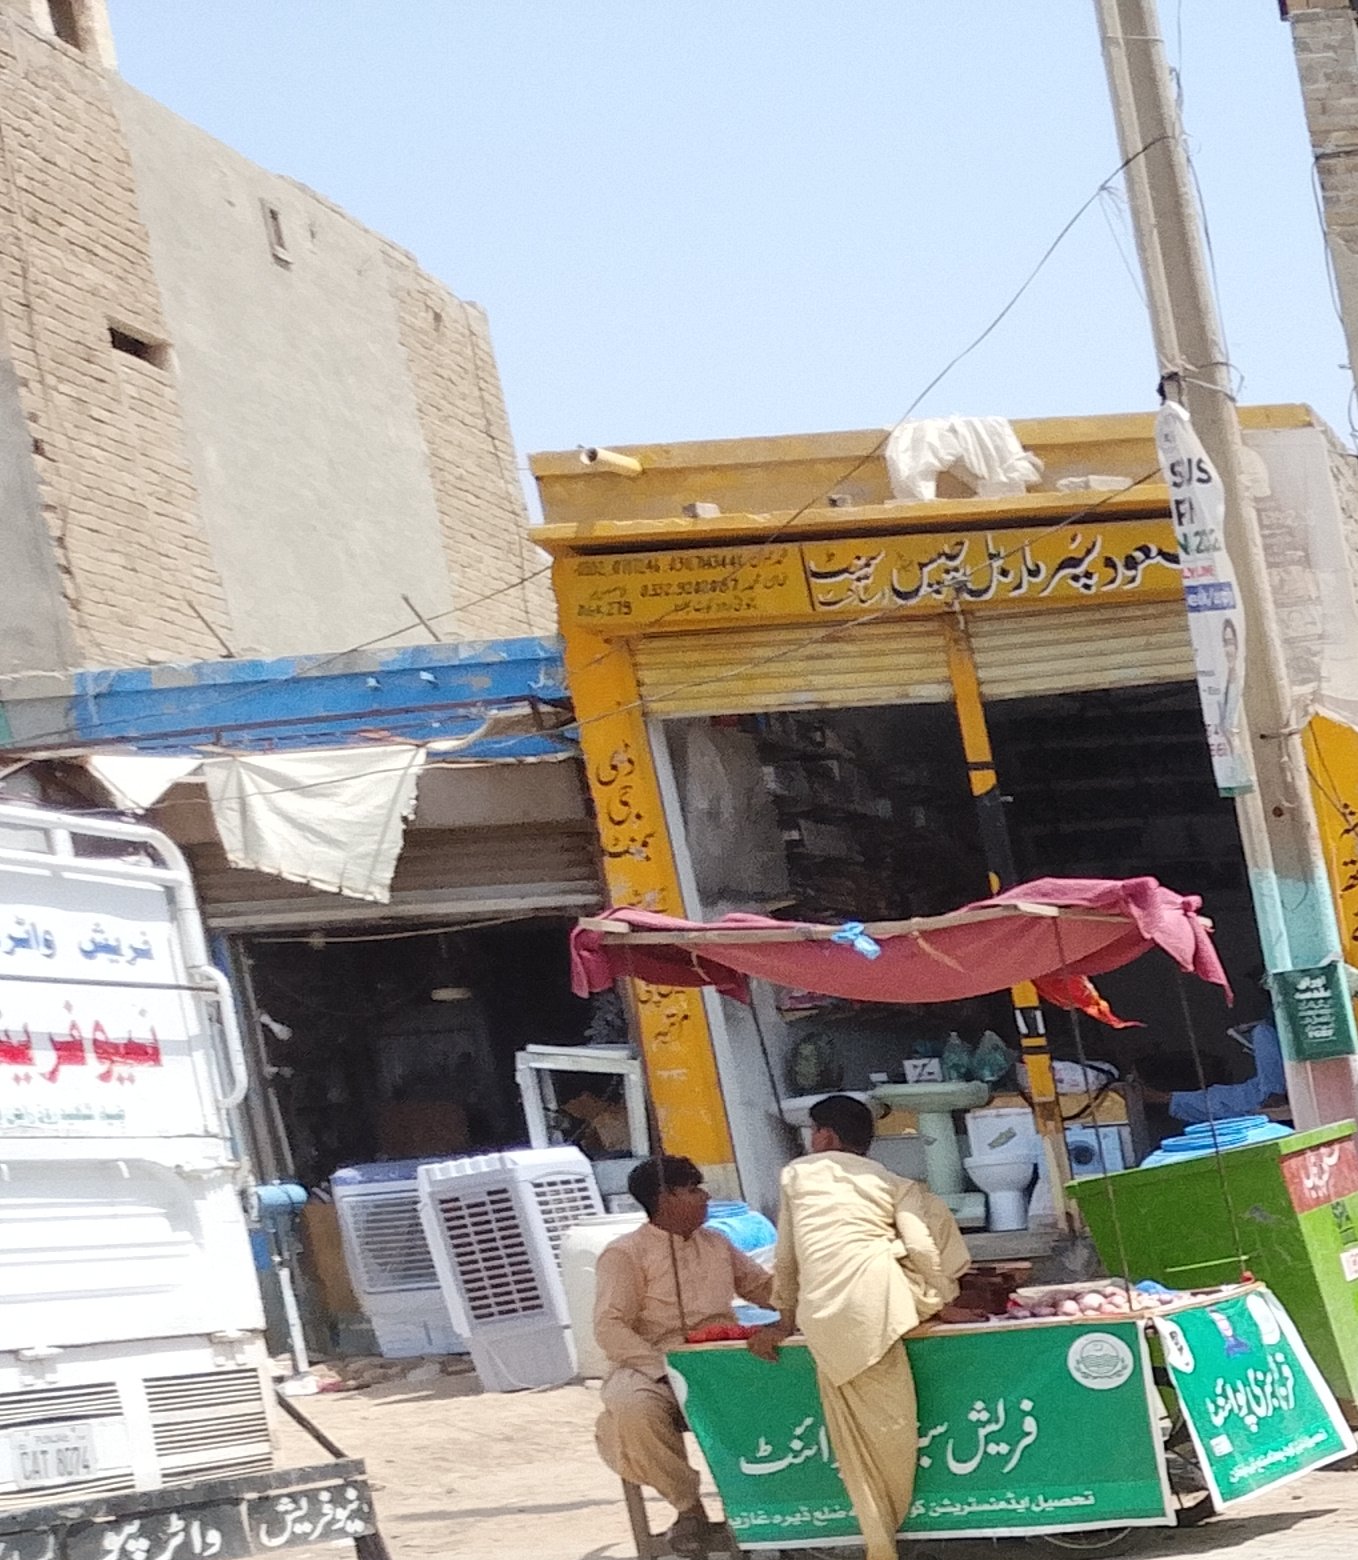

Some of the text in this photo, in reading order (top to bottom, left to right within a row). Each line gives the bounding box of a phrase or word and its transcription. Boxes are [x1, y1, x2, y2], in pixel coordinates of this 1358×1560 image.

[77, 921, 155, 966] فریش
[945, 1397, 1039, 1476] فریش
[259, 1489, 336, 1548] فریش
[812, 1505, 847, 1527] ضلع
[1031, 1490, 1096, 1513] تحصیل
